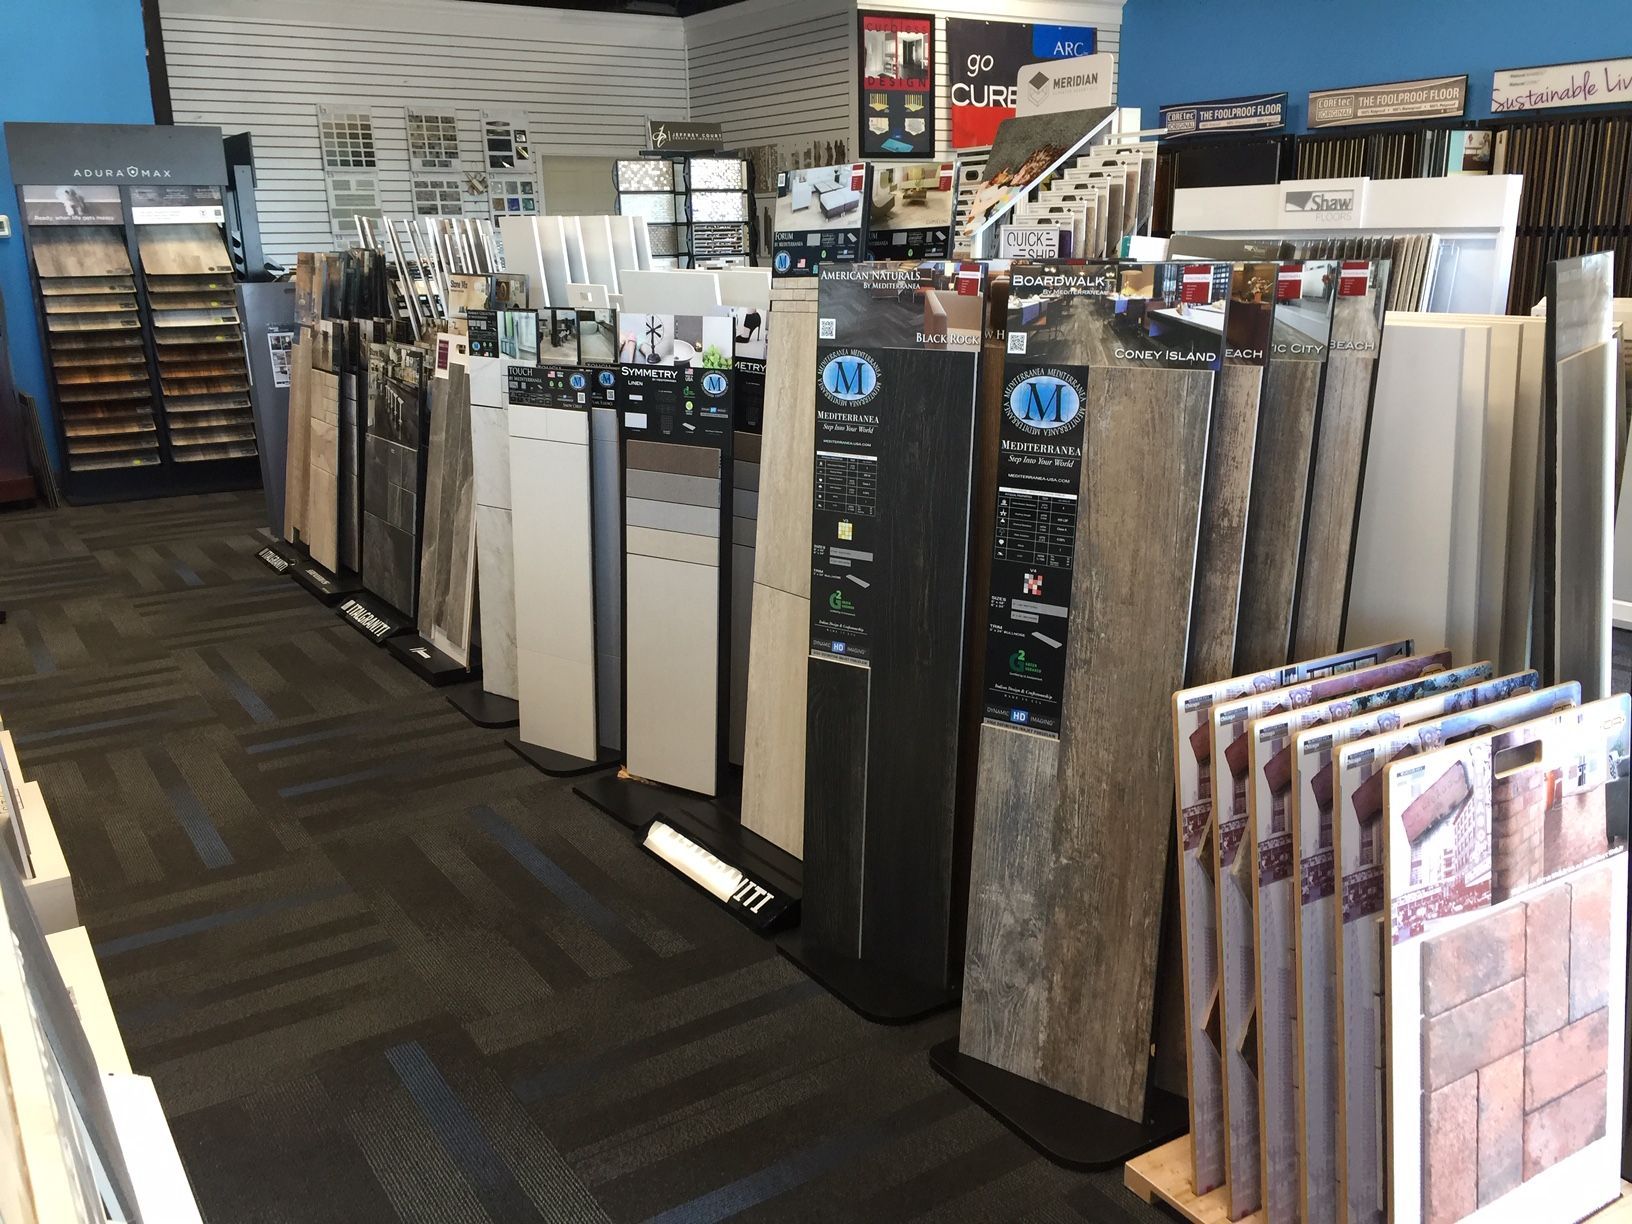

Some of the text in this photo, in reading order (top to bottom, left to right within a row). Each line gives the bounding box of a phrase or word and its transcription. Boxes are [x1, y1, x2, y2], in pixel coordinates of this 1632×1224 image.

[1053, 41, 1084, 57] ARC
[967, 54, 994, 78] go
[867, 77, 927, 88] DESIGN
[1053, 72, 1099, 90] MERIDIAN
[1359, 88, 1460, 107] THE FOOLPROOF FLOOR
[1200, 103, 1281, 121] THE FOOLPROOF FLOOR
[73, 169, 172, 178] ADURA MAX
[1311, 193, 1352, 211] Shaw
[1315, 212, 1352, 222] FLOORS
[1006, 231, 1045, 247] QUICK
[820, 270, 921, 281] AMERICAN NATURALS
[1012, 275, 1106, 287] BOARDWALK
[1042, 288, 1053, 296] BY
[916, 332, 980, 346] BLACK ROCK
[1115, 348, 1217, 363] CONEY ISLAND
[1290, 343, 1324, 355] CITY
[508, 367, 533, 376] TOUCH
[621, 366, 678, 379] SYMMETRY
[832, 361, 867, 395] M
[1021, 382, 1067, 422] M
[817, 411, 880, 424] MEDITERRANEA
[823, 423, 834, 431] Step
[859, 426, 874, 434] World
[1001, 440, 1081, 456] MEDITERRANEA
[1008, 454, 1075, 468] Step Into Your World
[1007, 473, 1071, 484] MEDITERRANEA-USA.COM
[345, 603, 391, 637] ITALGRANITI
[833, 644, 844, 652] HD
[986, 706, 1054, 726] DYNAMIC HD IMAGING
